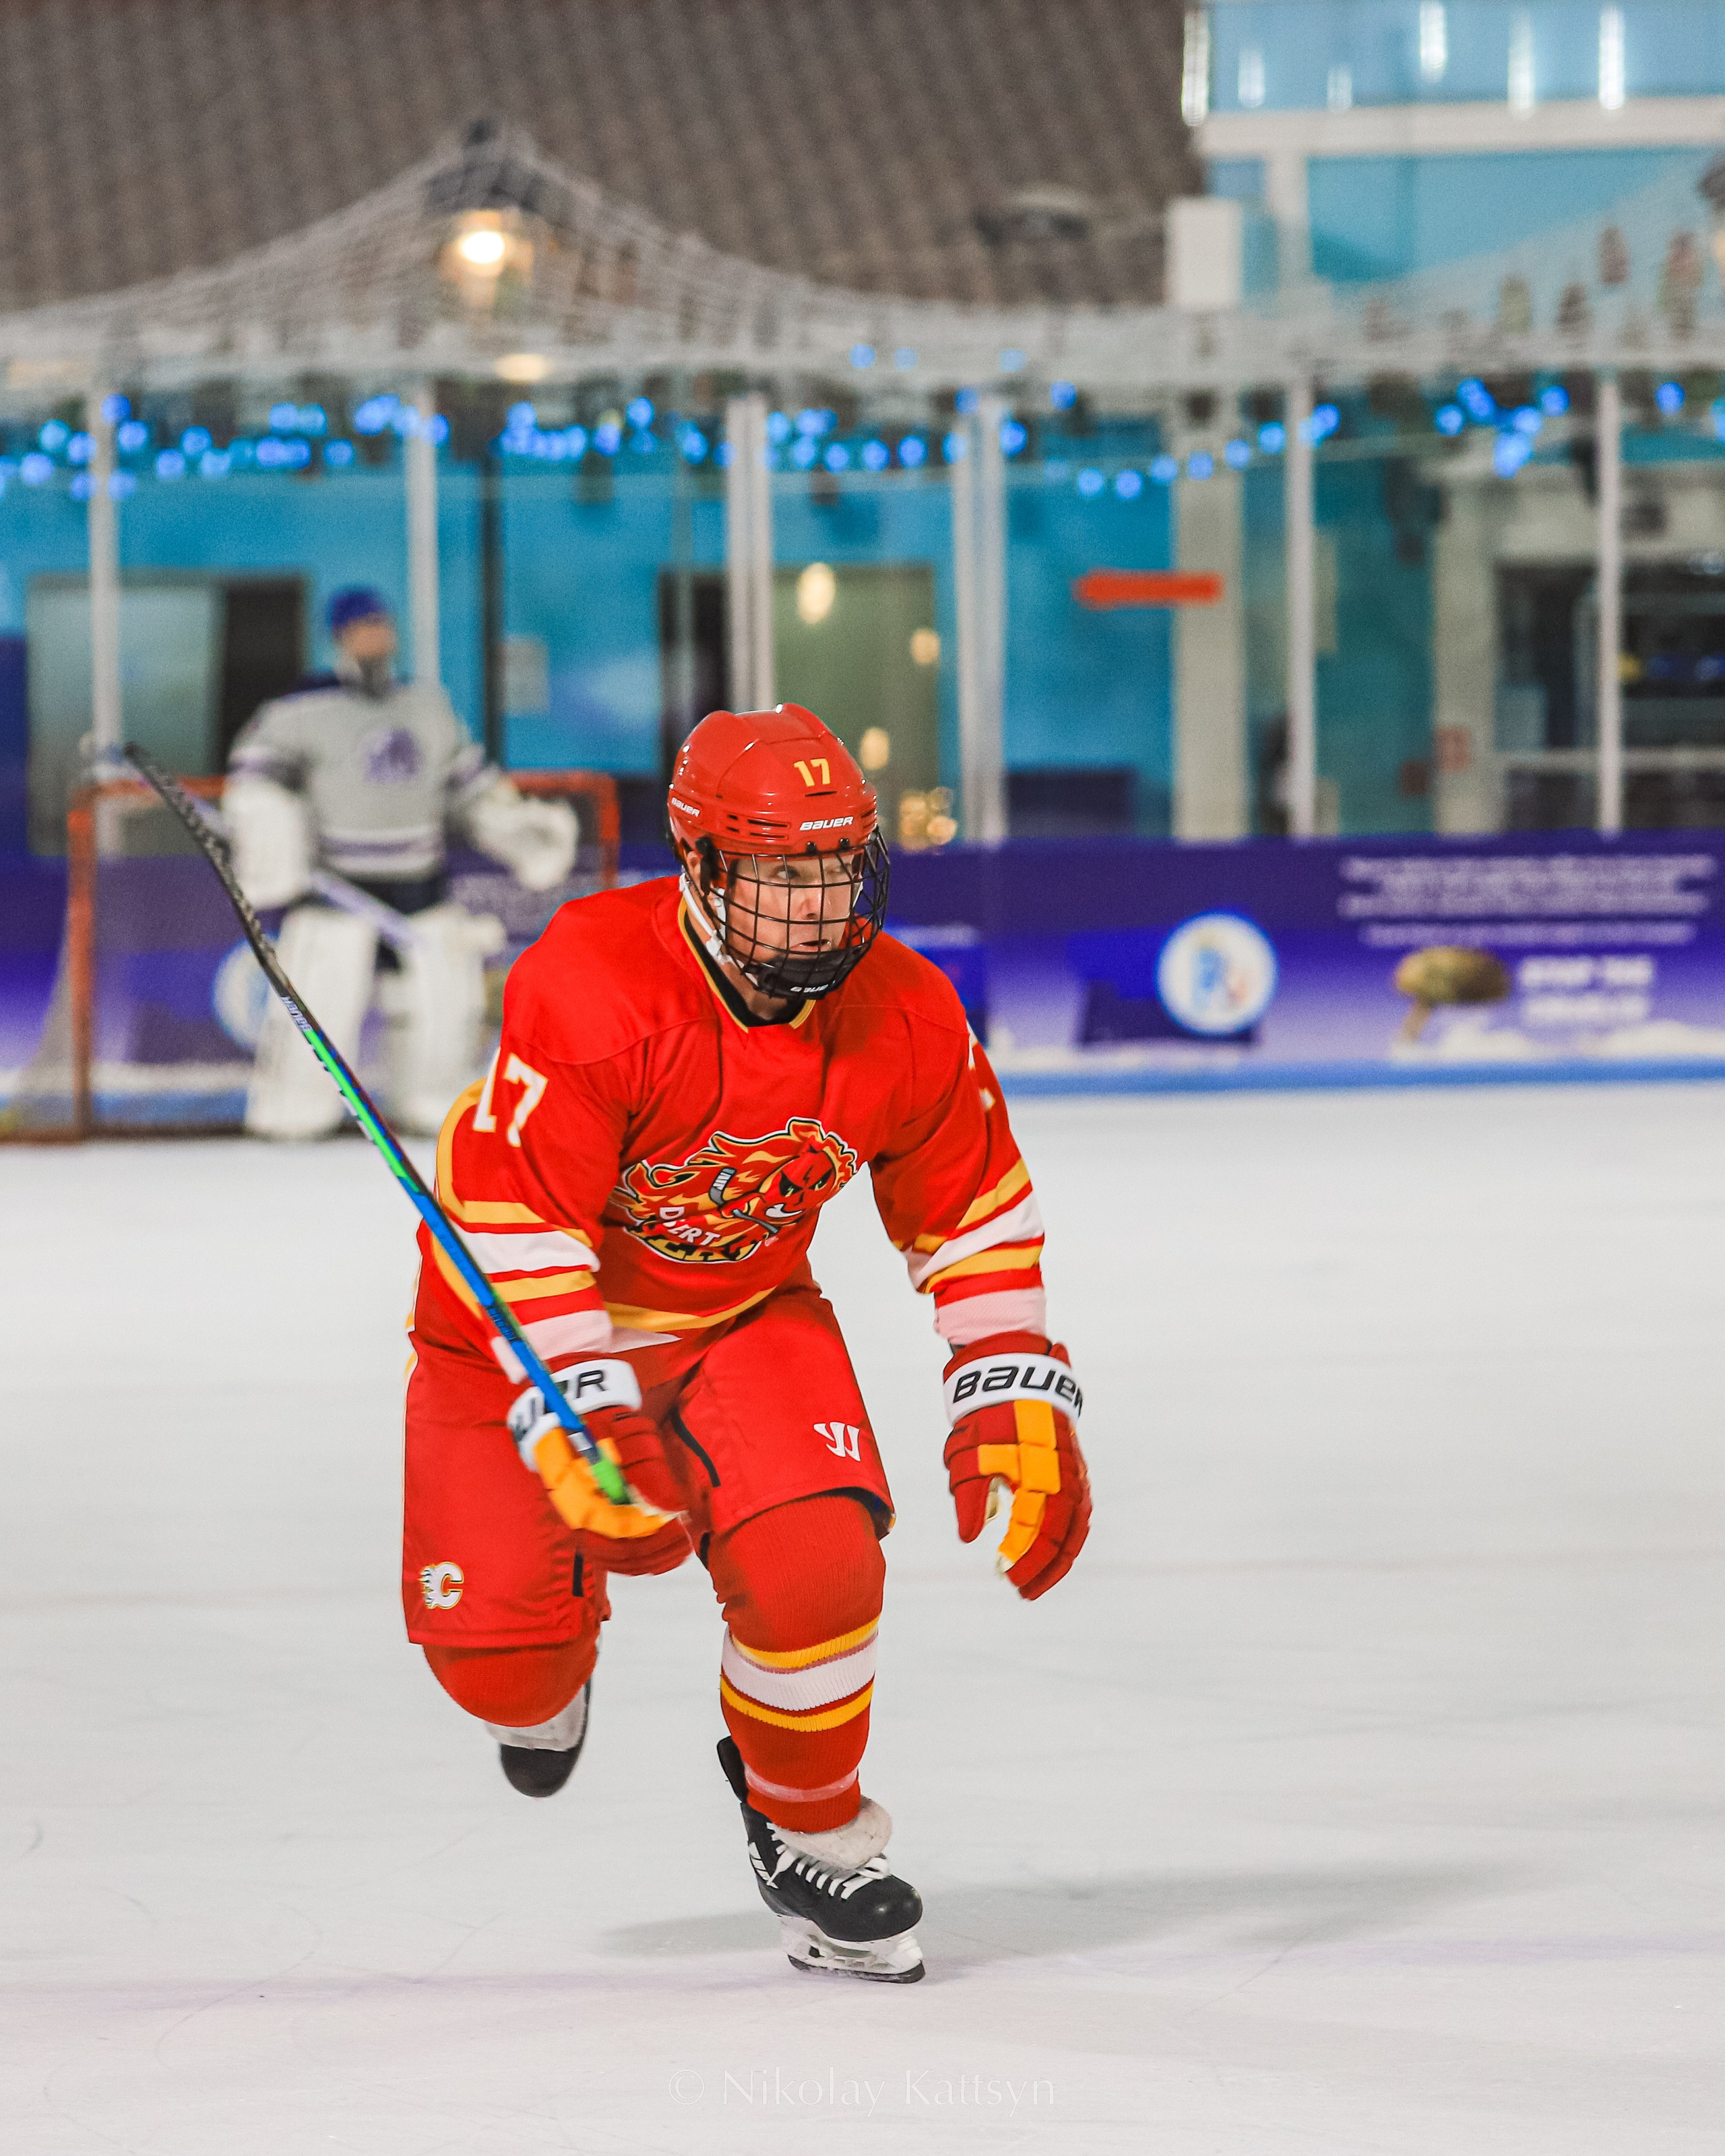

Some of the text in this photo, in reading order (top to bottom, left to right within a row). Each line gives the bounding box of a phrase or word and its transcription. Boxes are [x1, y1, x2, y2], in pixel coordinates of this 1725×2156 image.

[793, 758, 831, 788] 17
[670, 797, 701, 817] BAUER
[799, 816, 854, 831] BAUER
[472, 1045, 548, 1147] 17
